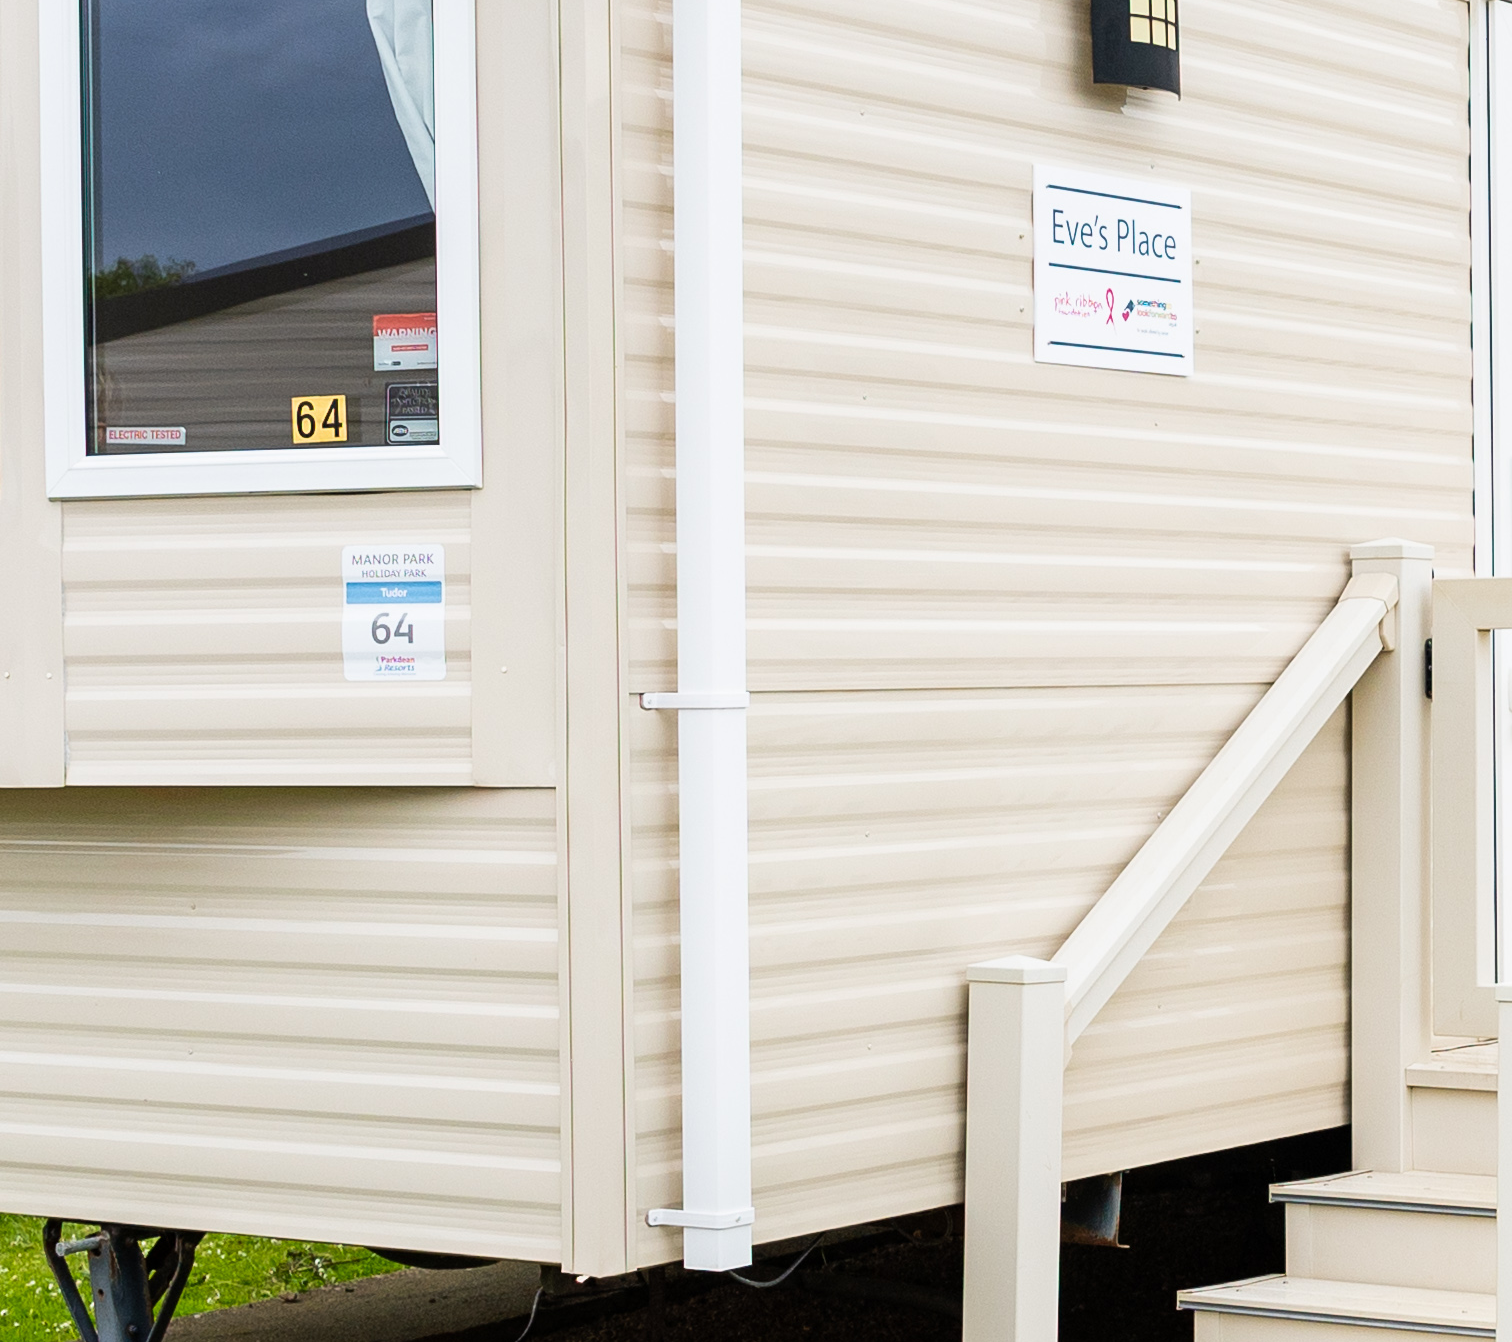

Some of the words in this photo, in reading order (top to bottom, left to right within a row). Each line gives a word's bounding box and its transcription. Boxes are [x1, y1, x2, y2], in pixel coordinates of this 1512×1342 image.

[1052, 209, 1109, 251] Eve's
[1117, 219, 1177, 260] Place
[1054, 291, 1072, 311] pink
[1075, 293, 1103, 309] ribbon
[377, 327, 437, 339] WARNING
[296, 399, 343, 440] 64
[108, 429, 148, 440] ELECTRIC
[150, 429, 181, 440] TESTED
[351, 554, 399, 565] MANOR
[403, 553, 435, 565] PARK
[361, 569, 401, 578] HOLIDAY
[403, 569, 427, 578] PARK
[380, 587, 408, 598] Tudor
[371, 612, 414, 645] 64
[380, 656, 416, 664] Parkdean
[384, 664, 415, 672] Resorts
